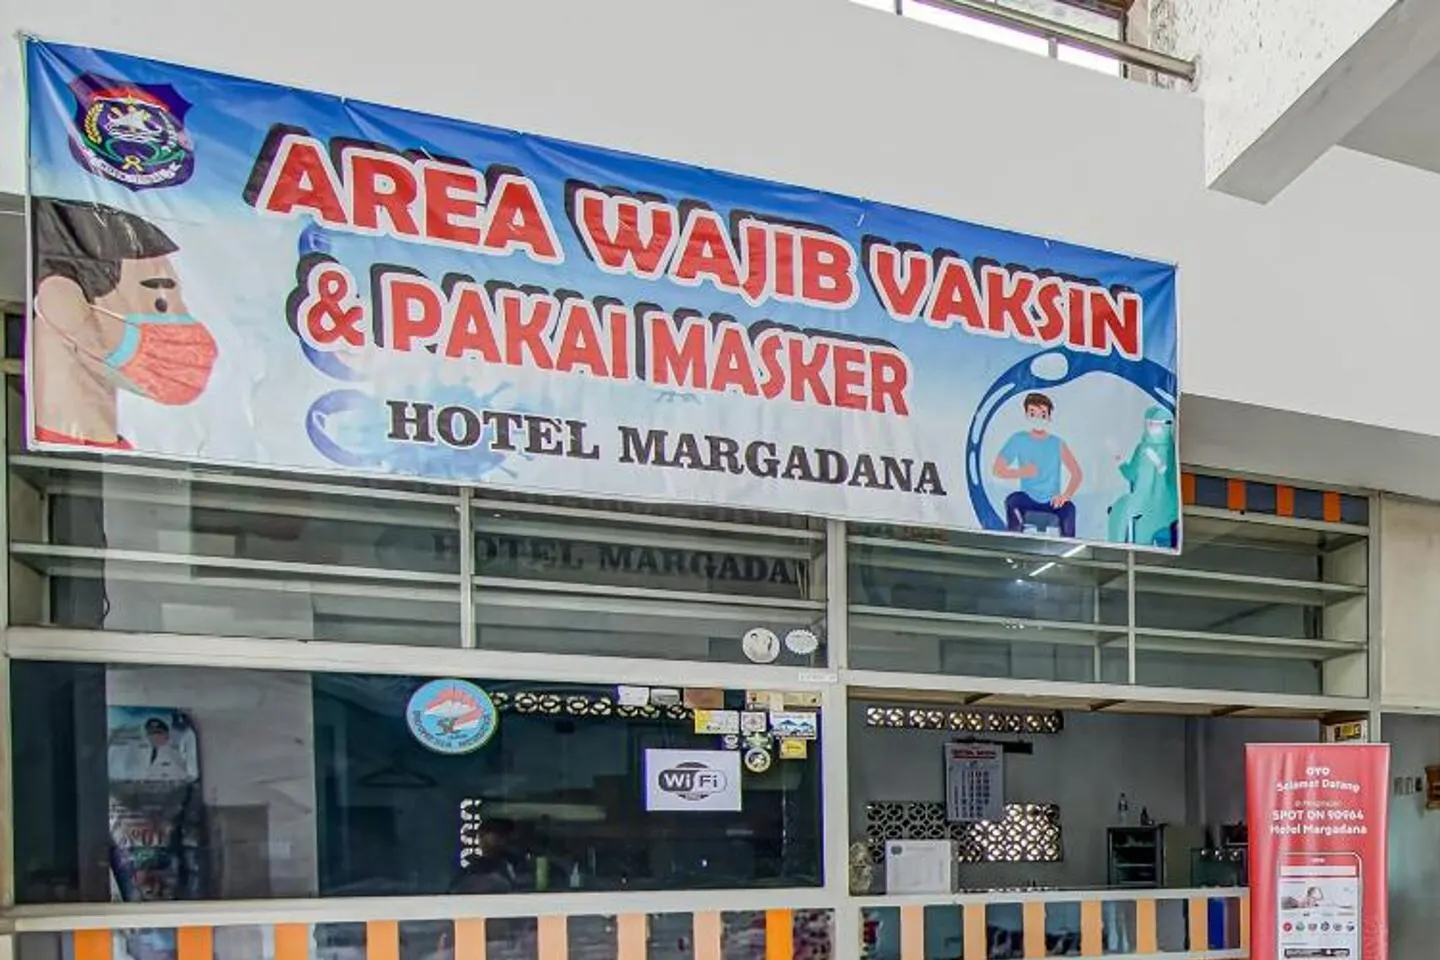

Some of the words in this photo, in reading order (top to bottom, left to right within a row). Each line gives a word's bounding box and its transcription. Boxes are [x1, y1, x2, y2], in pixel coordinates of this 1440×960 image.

[262, 132, 565, 262] AREA
[572, 190, 859, 310] WAJIB
[868, 242, 1142, 362] VAKSIN
[298, 260, 368, 352] &
[385, 272, 630, 384] PAKAI
[645, 306, 912, 418] MASKER
[387, 400, 601, 460] HOTEL
[618, 426, 948, 497] MARGADANA
[1306, 766, 1330, 776] OYO
[1272, 810, 1305, 820] SPOT
[1307, 810, 1325, 820] ON
[1303, 823, 1368, 836] Margadana
